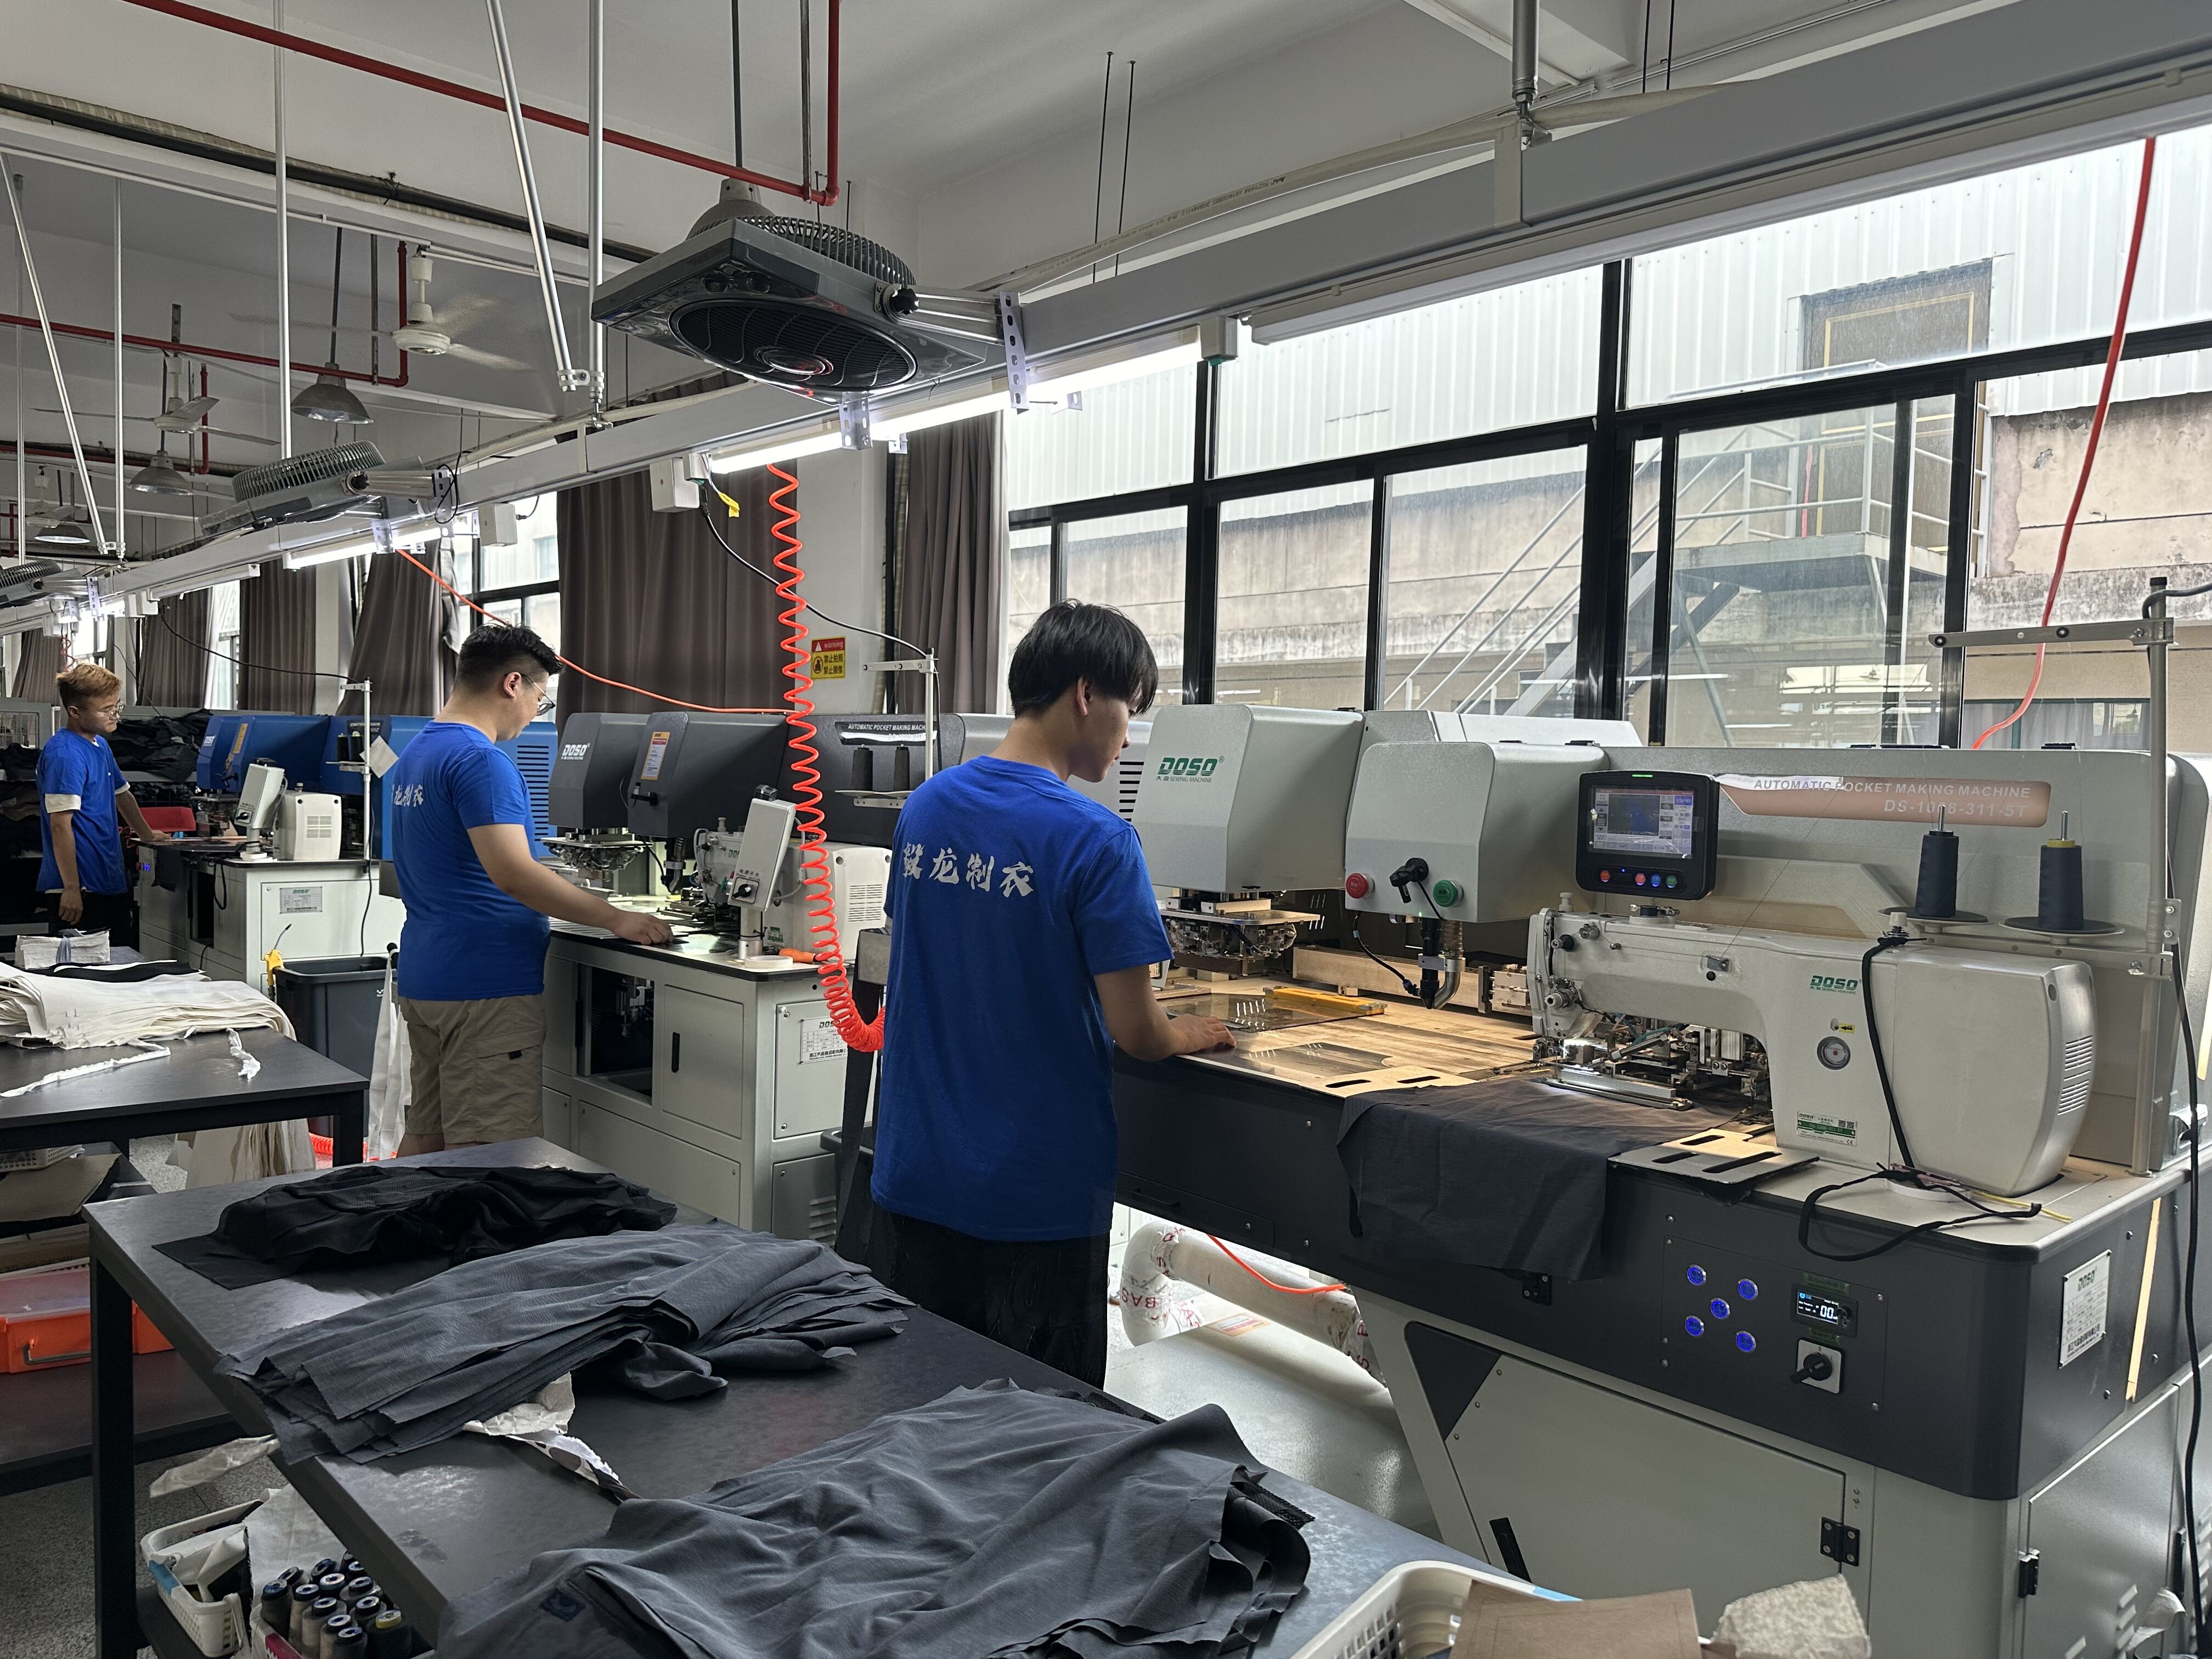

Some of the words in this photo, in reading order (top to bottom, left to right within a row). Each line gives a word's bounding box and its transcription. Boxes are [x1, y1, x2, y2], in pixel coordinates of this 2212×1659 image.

[824, 641, 843, 650] warning
[562, 744, 588, 756] DOSO
[1158, 757, 1218, 776] DOSO
[392, 783, 424, 808] 龙制衣
[1754, 780, 1831, 791] AUTOMATIC
[1835, 781, 1892, 793] POCKET
[1895, 783, 1954, 795] MAKING
[1958, 785, 2030, 798] MACHINE
[729, 849, 740, 859] DO
[1810, 975, 1858, 991] DOSO
[819, 1020, 834, 1029] DOS
